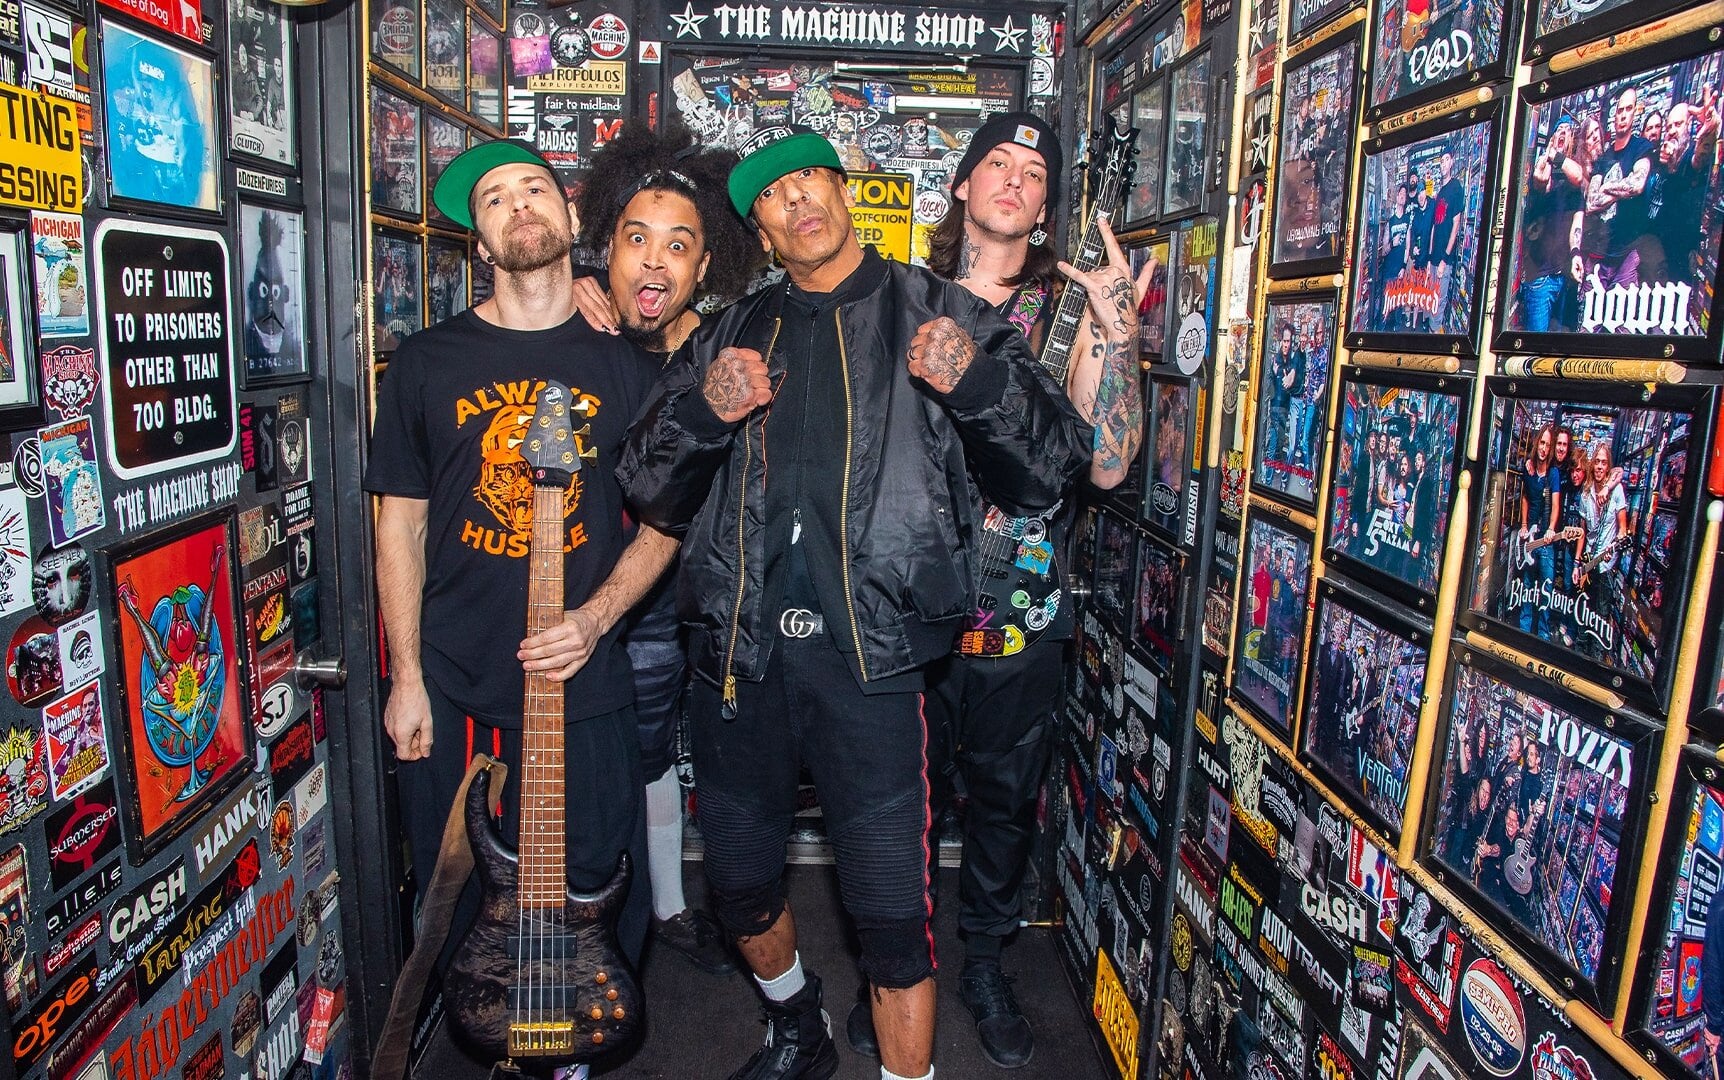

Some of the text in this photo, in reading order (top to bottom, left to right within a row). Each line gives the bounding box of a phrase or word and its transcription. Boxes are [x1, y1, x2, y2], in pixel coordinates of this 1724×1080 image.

[150, 2, 169, 26] Dog
[714, 4, 985, 49] THE MACHINE SHOP
[591, 30, 626, 44] MACHINE
[47, 84, 91, 104] WARNING
[533, 82, 620, 90] AMPLIFICATION
[545, 96, 621, 111] fair to midland
[237, 136, 261, 153] CLUTCH
[539, 130, 577, 152] BADASS
[847, 179, 911, 206] ION
[31, 216, 81, 239] MICHIGAN
[122, 267, 213, 299] OFF LIMITS
[1582, 262, 1692, 336] down
[1383, 288, 1440, 317] hatebreed
[115, 311, 222, 343] TO PRISONERS
[42, 353, 94, 379] MACHINE
[125, 352, 219, 388] OTHER THAN
[133, 394, 217, 432] 700 BLDG.
[456, 380, 602, 428] ALWS
[42, 421, 88, 443] MICHIGAN
[240, 407, 255, 471] SUM 41
[113, 461, 240, 535] THE MACHINE SHOP
[284, 497, 312, 517] FOR LIFE
[461, 520, 588, 558] HUSE
[1366, 508, 1400, 537] FOXY
[1364, 529, 1411, 557] SHAZAM
[41, 551, 82, 573] SEETHER
[243, 567, 287, 601] VENTANA
[1508, 577, 1614, 651] Black Stone Cherry
[1537, 663, 1565, 687] FLAW
[51, 706, 82, 734] MACHINE
[262, 690, 288, 729] SJ
[58, 726, 77, 746] SHOP
[1538, 708, 1632, 788] FOZZY
[1198, 747, 1230, 789] HURT
[50, 806, 117, 860] SUBMERSED
[194, 789, 257, 874] HANK
[47, 865, 122, 930] allele
[109, 865, 187, 943] CASH
[1176, 868, 1213, 938] HANK
[1220, 876, 1253, 940] FAR-LESS
[1302, 883, 1367, 942] CASH
[47, 920, 101, 971] Psychostick
[95, 905, 177, 993] Smile Empty Soul
[1217, 916, 1266, 993] SEVEN SONNET
[1469, 981, 1517, 1043] SEMI-PRO
[1471, 1014, 1503, 1056] 02-29-08
